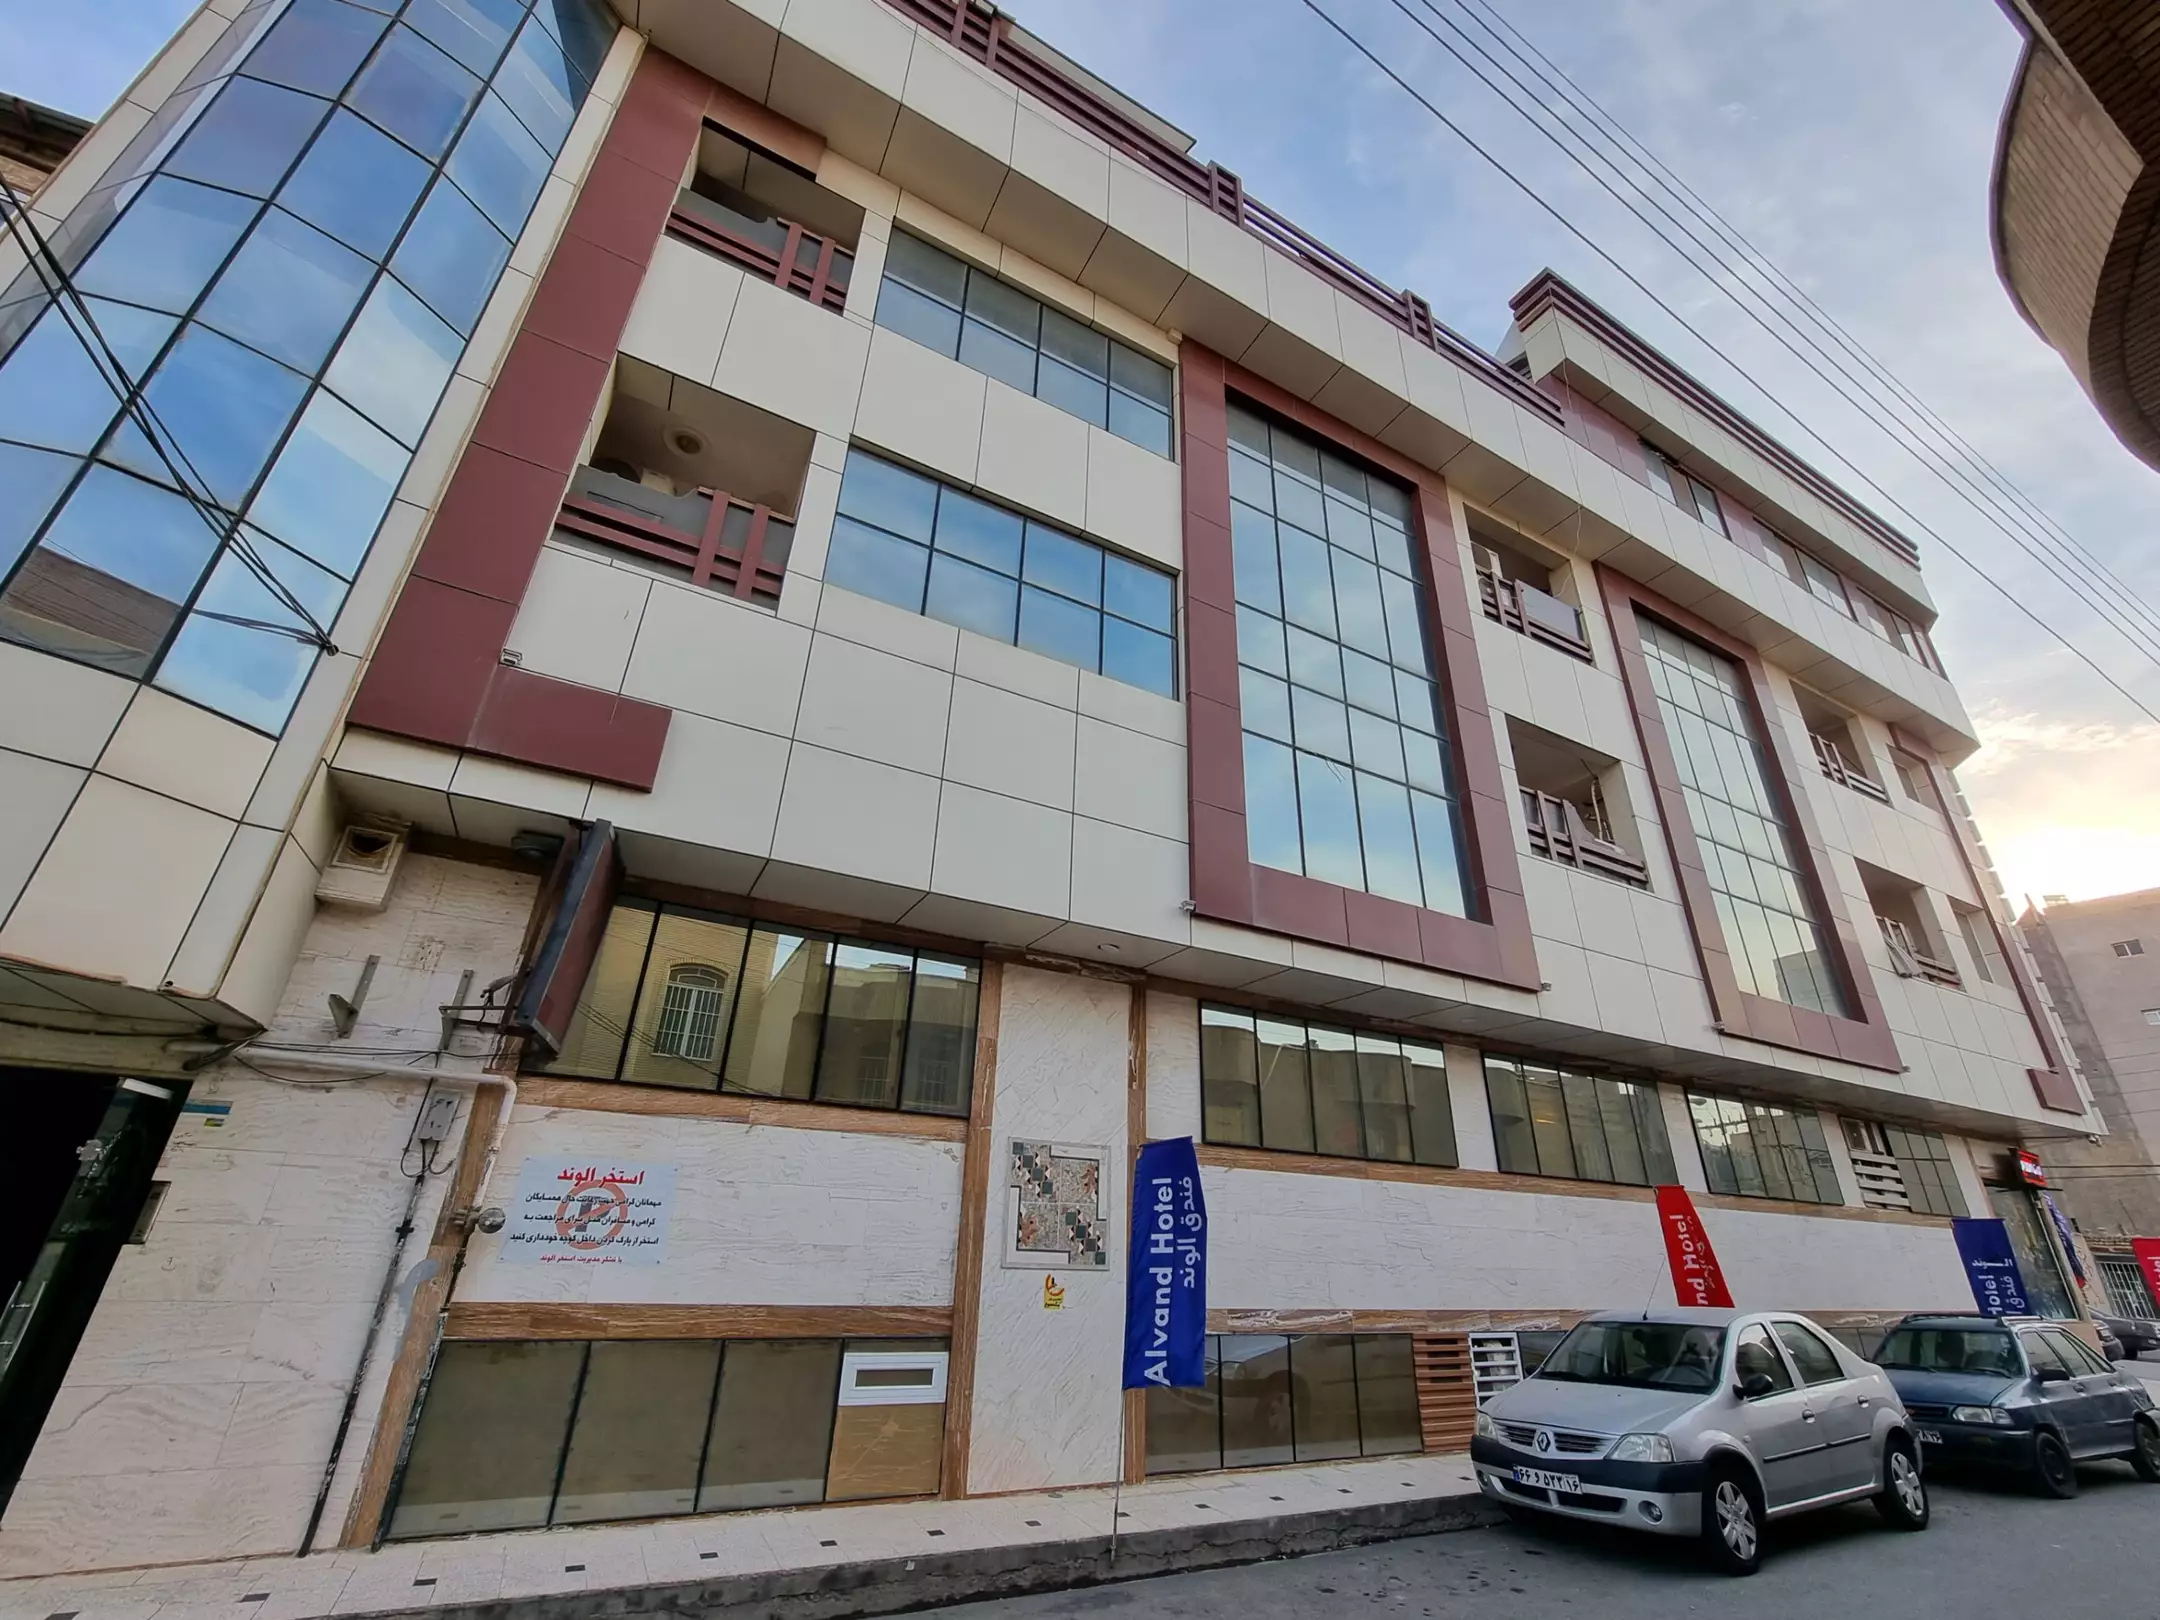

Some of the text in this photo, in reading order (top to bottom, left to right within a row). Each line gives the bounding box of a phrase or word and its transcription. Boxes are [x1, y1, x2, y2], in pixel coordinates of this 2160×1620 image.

[557, 1166, 645, 1188] استخر الوند
[525, 1192, 561, 1203] همسایگان
[561, 1194, 576, 1205] حال
[576, 1195, 599, 1206] رعایت
[615, 1196, 635, 1207] گرامی
[634, 1198, 662, 1208] مهمانان
[523, 1213, 534, 1222] به
[534, 1213, 564, 1224] مراجعت
[564, 1213, 583, 1224] برای
[601, 1215, 631, 1226] مسافران
[635, 1217, 656, 1227] گرامی
[510, 1232, 526, 1242] کنید
[1177, 1176, 1202, 1289] فندق الوند
[527, 1233, 558, 1244] خودداری
[559, 1235, 577, 1245] کوچه
[578, 1235, 596, 1245] داخل
[596, 1235, 615, 1245] کردن
[615, 1236, 632, 1246] پارک
[637, 1236, 659, 1245] استخر
[577, 1255, 600, 1263] مدیریت
[1144, 1177, 1174, 1387] Alvand Hotel
[2000, 1276, 2025, 1309] فندق
